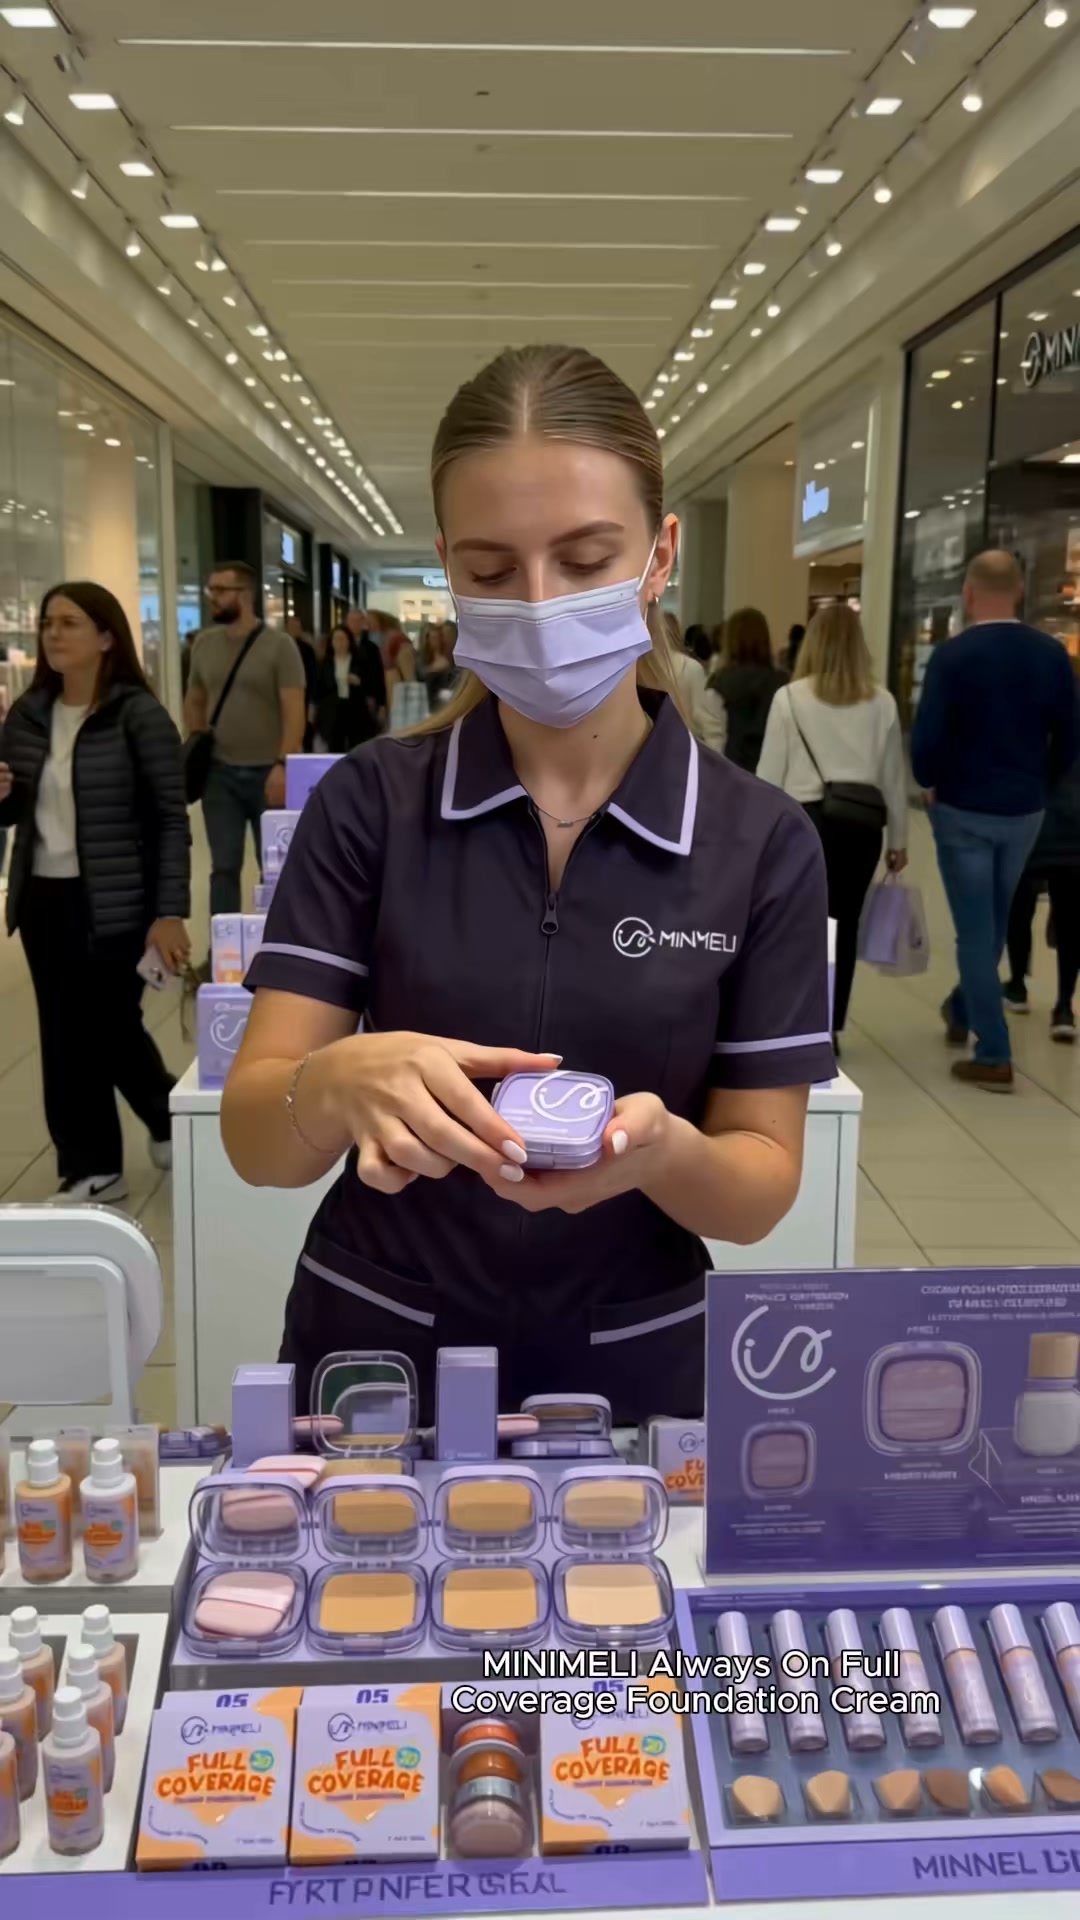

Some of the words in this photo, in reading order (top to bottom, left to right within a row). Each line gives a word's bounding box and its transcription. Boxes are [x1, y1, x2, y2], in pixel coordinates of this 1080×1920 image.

[580, 1736, 640, 1756] FULL
[187, 1752, 246, 1773] FULL
[335, 1748, 394, 1770] FULL
[555, 1757, 670, 1781] COVERAGE
[157, 1773, 276, 1797] COVERAGE
[307, 1769, 424, 1795] COVERAGE
